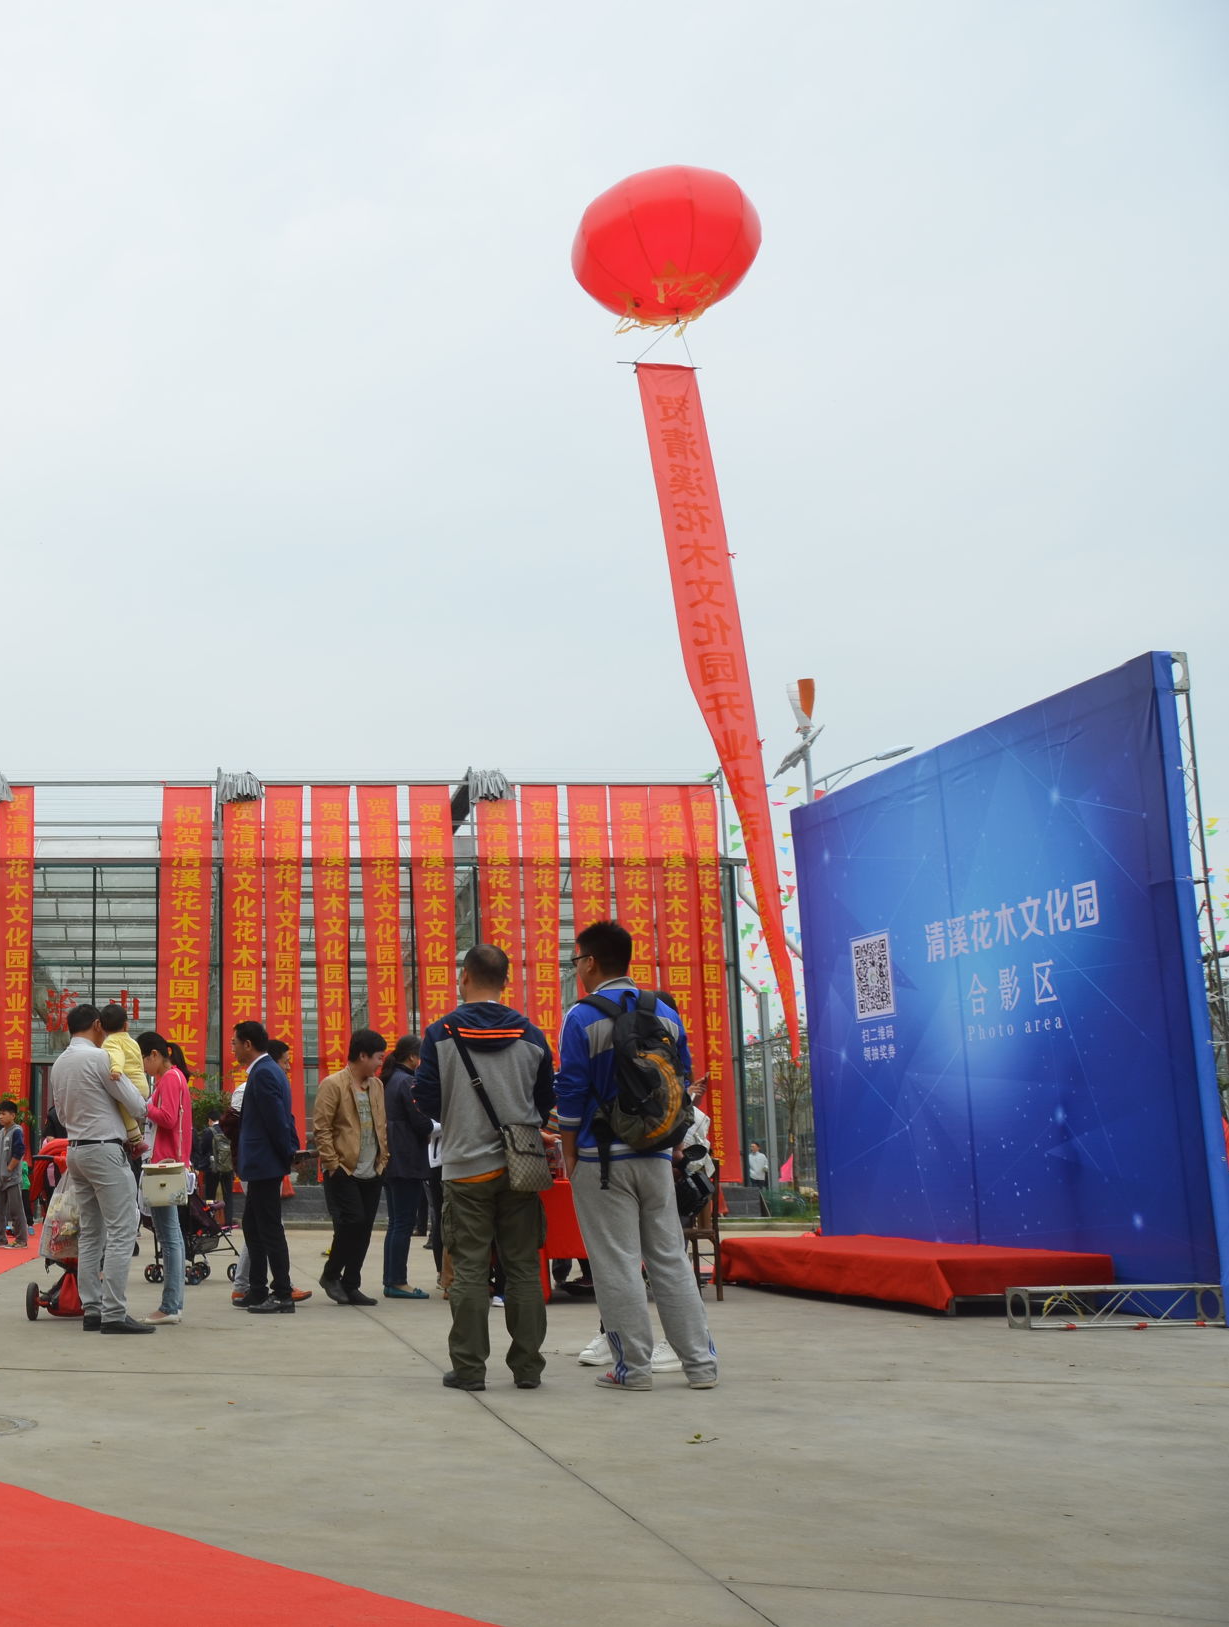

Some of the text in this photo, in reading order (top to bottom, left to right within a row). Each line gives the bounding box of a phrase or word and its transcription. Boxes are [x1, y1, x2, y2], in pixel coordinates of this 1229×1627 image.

[577, 804, 605, 925] 贺清溪花木
[4, 794, 29, 1059] 贺清溪花木文化园开业大吉
[925, 880, 1099, 963] 清溪花木文化园
[968, 960, 1058, 1016] 合影区
[862, 1025, 894, 1043] 扫二维码
[967, 1017, 1063, 1041] Photo area
